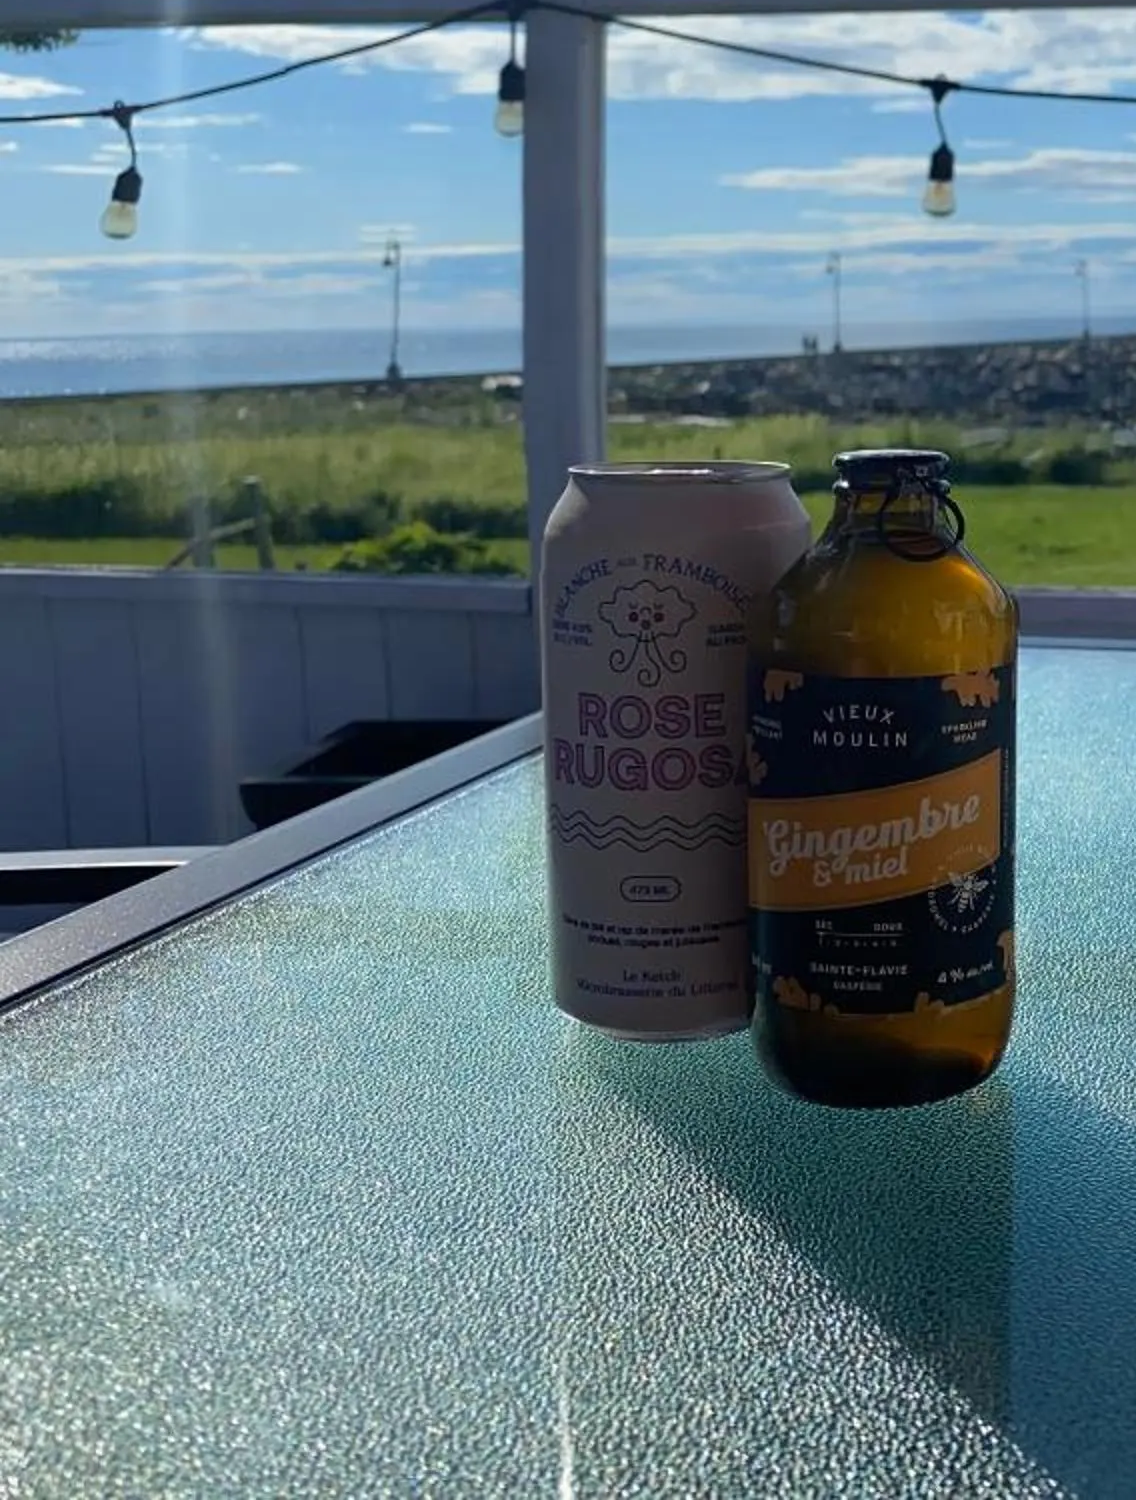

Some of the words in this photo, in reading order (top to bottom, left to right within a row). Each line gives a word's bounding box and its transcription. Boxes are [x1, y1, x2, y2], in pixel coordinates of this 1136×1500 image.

[578, 692, 727, 739] ROSE
[823, 704, 895, 725] VIEUX
[813, 731, 908, 747] MOULIN
[763, 794, 980, 877] Gingembre
[813, 860, 832, 887] &
[845, 845, 908, 885] miel
[810, 961, 908, 977] SAINTE-FLAVIE
